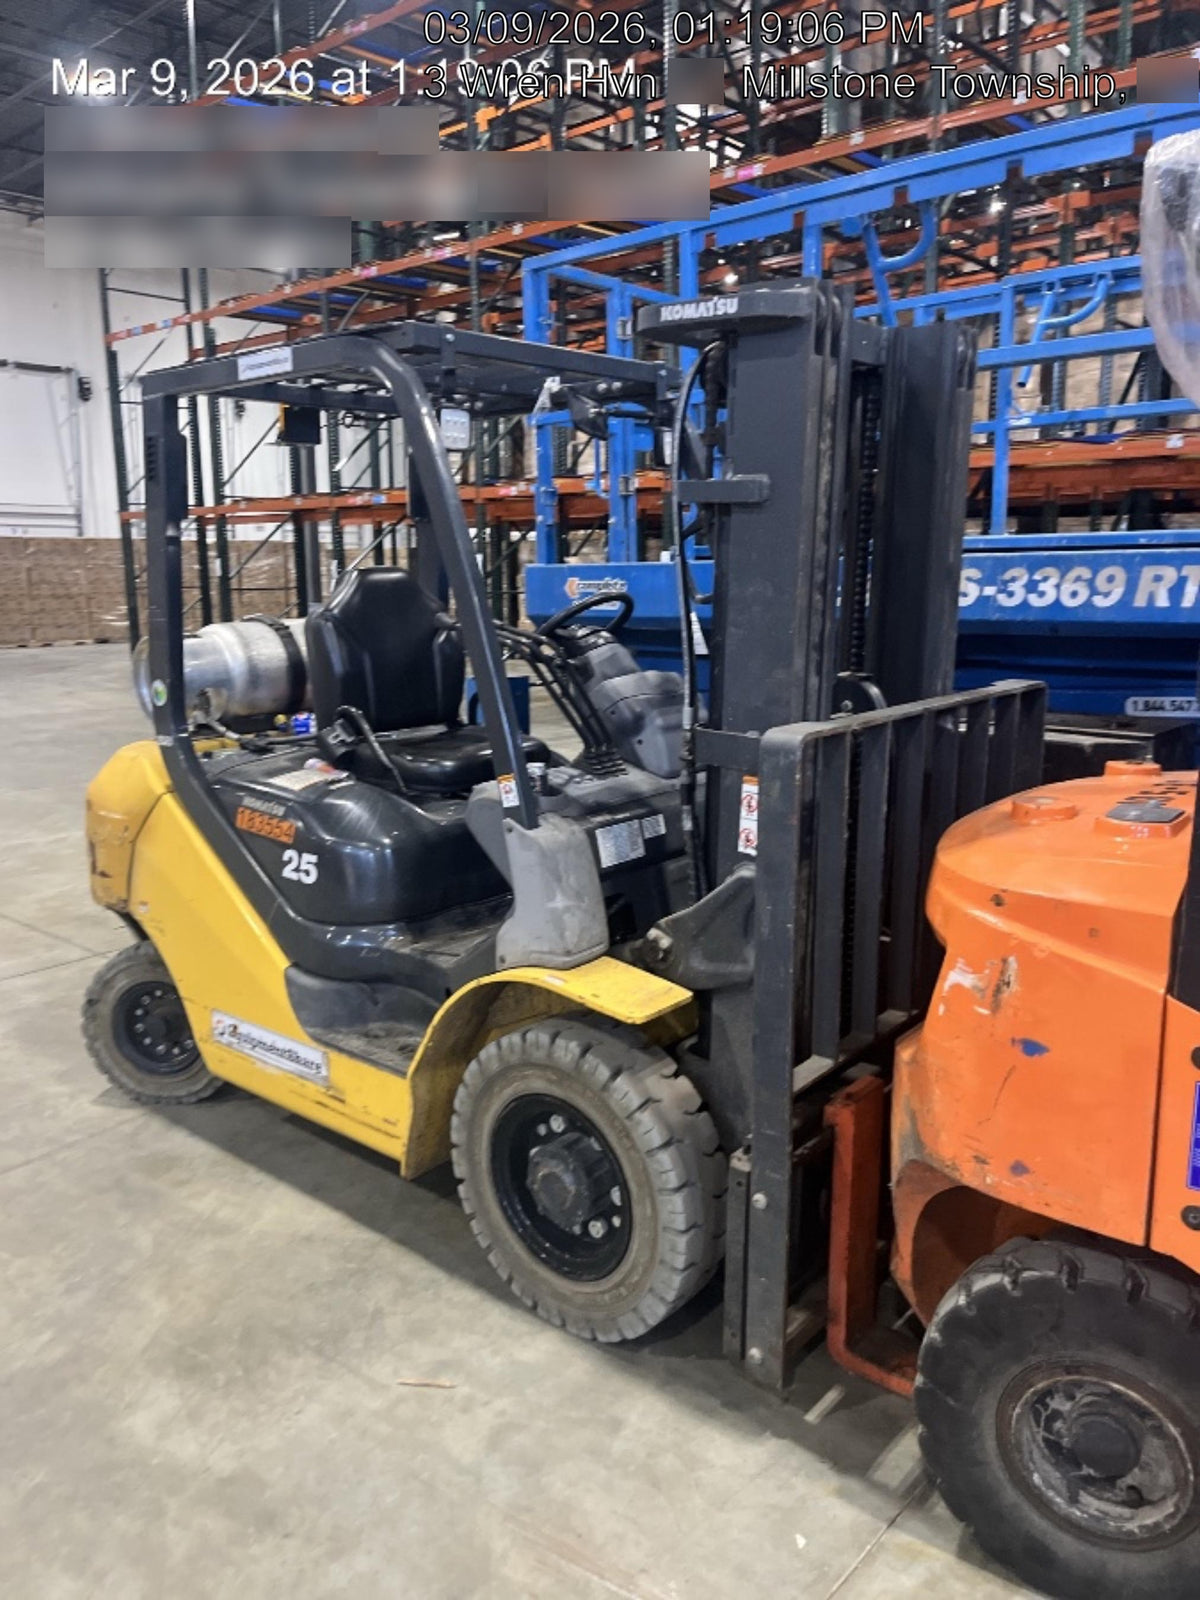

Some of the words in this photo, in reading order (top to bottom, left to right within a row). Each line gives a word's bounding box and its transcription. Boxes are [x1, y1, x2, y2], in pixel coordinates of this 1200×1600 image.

[660, 296, 738, 321] KOMATSU
[1132, 565, 1200, 608] RT
[282, 848, 319, 885] 25
